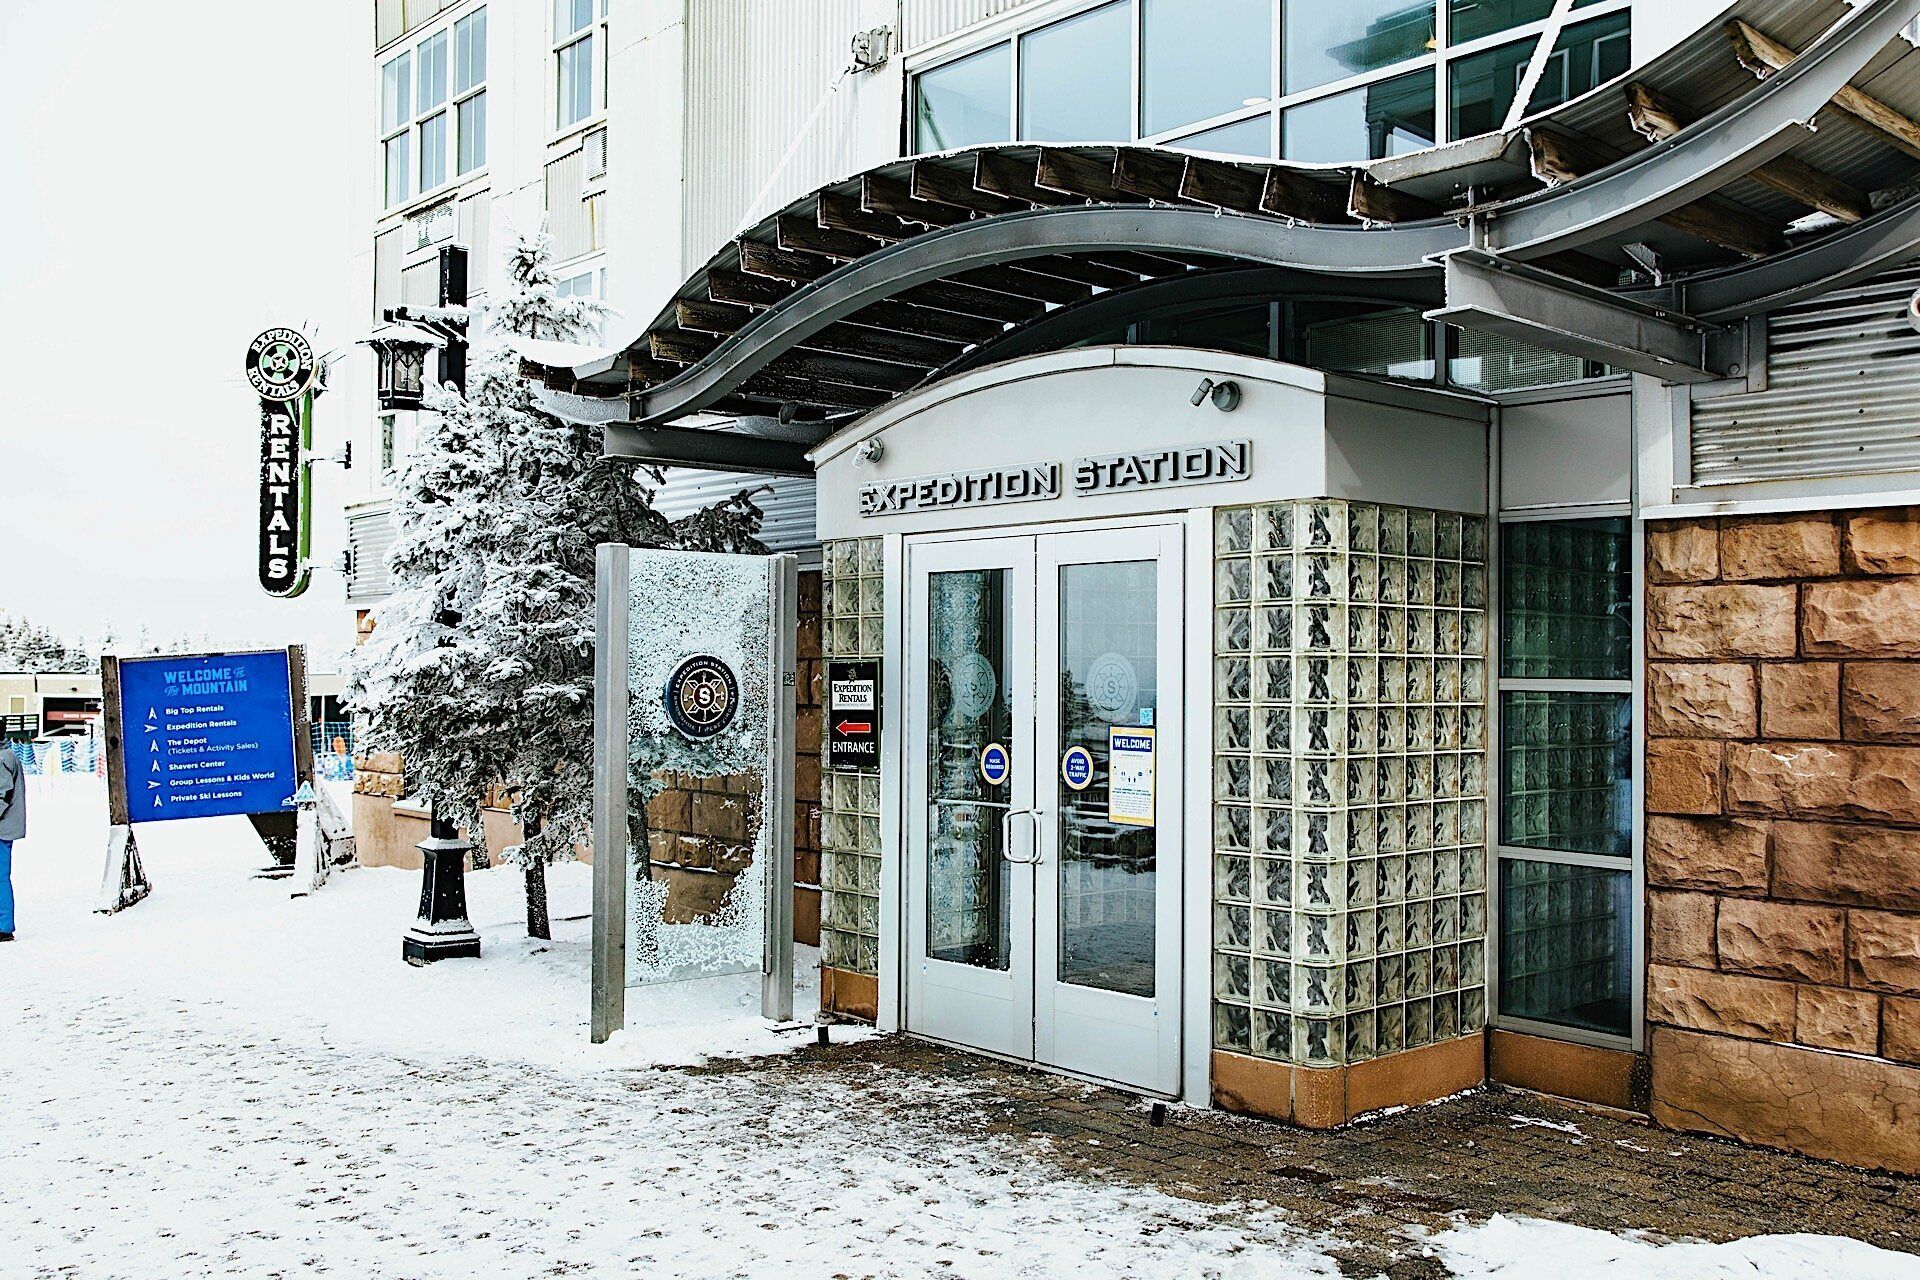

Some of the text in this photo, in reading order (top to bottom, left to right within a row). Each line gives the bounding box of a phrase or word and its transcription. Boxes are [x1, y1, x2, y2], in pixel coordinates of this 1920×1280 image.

[251, 329, 313, 370] EXPEDITION
[248, 366, 300, 397] RENTALS
[858, 443, 1246, 514] EXPEDITION STATION
[267, 414, 292, 579] RENTALS
[163, 668, 232, 684] WELCOME
[675, 660, 732, 689] EXPEDITION STATION
[164, 680, 248, 697] The MOUNTAIN
[834, 684, 872, 693] EXPEDITION
[839, 693, 867, 703] RENTALS
[166, 708, 179, 716] Big
[196, 705, 224, 713] Rentals
[166, 720, 237, 731] Expedition Rentals
[168, 747, 198, 755] (Tickets
[206, 744, 235, 752] Activity
[236, 742, 259, 750] Sales)
[832, 742, 874, 753] ENTRANCE
[1114, 737, 1151, 750] WELCOME
[195, 776, 225, 784] Lessons
[251, 772, 275, 780] World
[199, 792, 211, 800] Ski
[212, 791, 242, 799] Lessons
